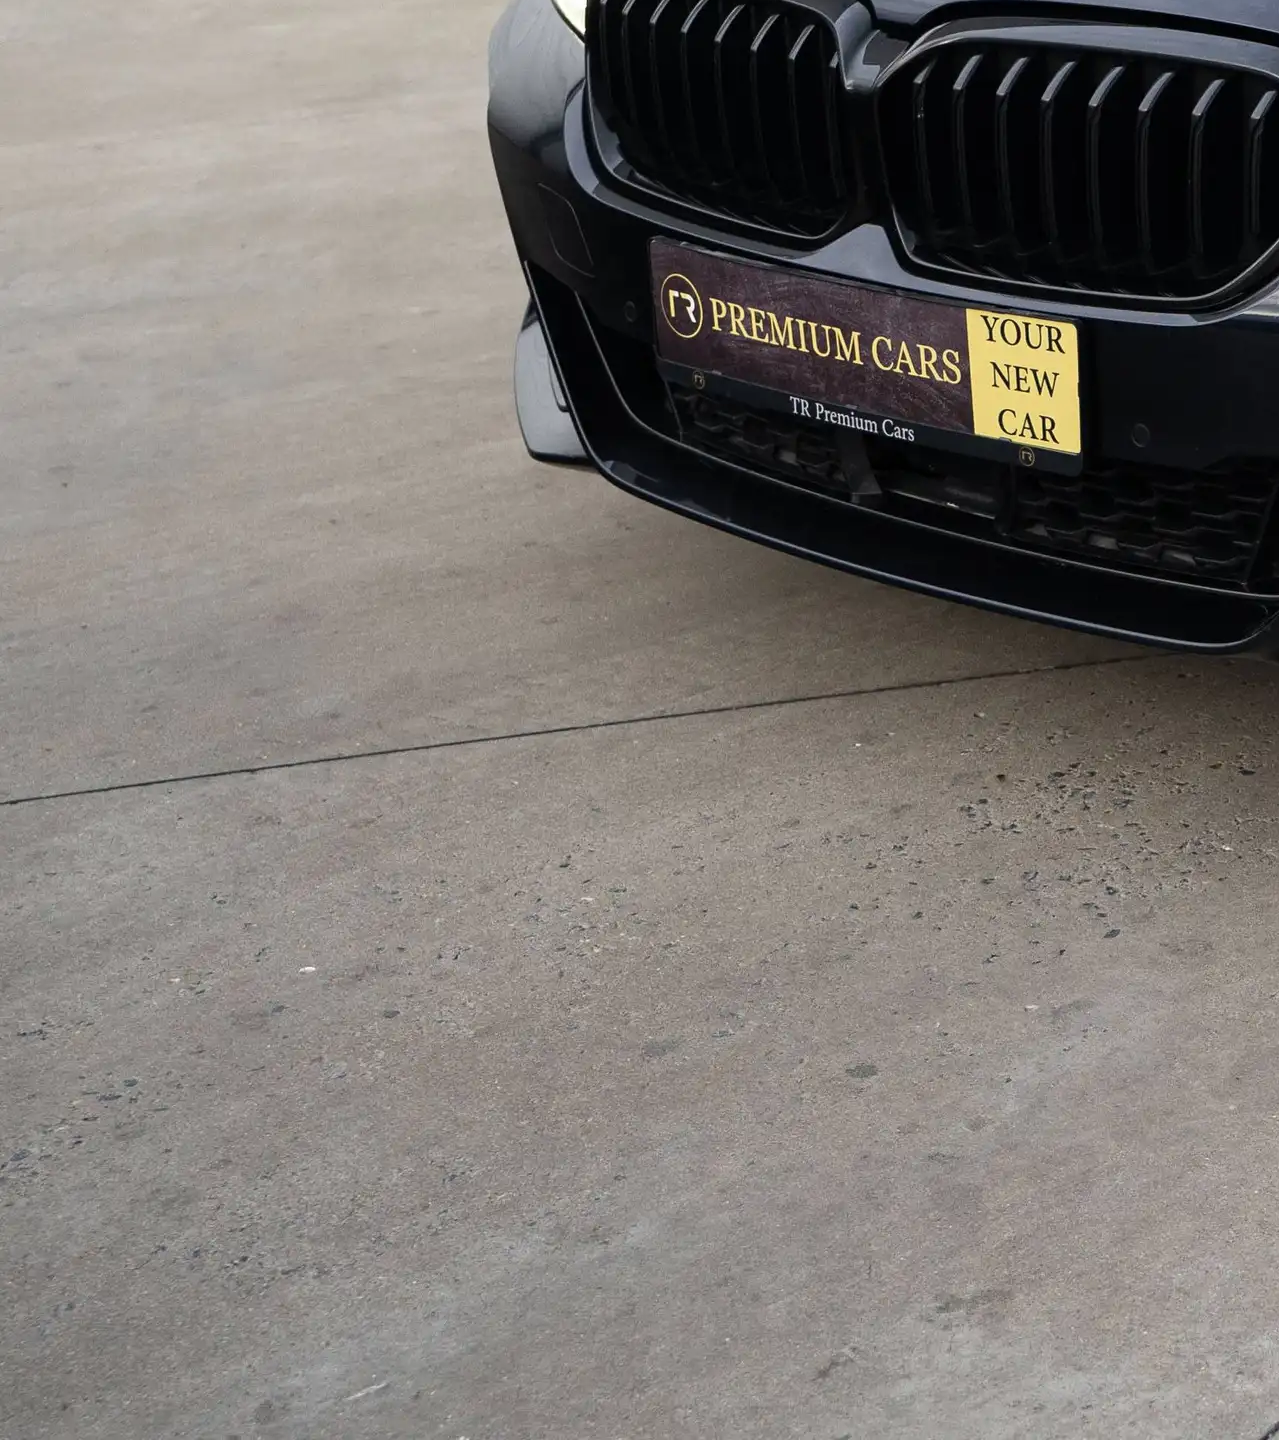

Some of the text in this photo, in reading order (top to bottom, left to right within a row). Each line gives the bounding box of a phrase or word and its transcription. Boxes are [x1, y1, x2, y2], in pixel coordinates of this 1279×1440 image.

[709, 297, 864, 365] PREMIUM
[871, 335, 962, 385] CARS
[980, 314, 1066, 355] YOUR
[990, 361, 1060, 399] NEW
[789, 395, 915, 443] TR Premium Cars
[997, 408, 1060, 445] CAR
